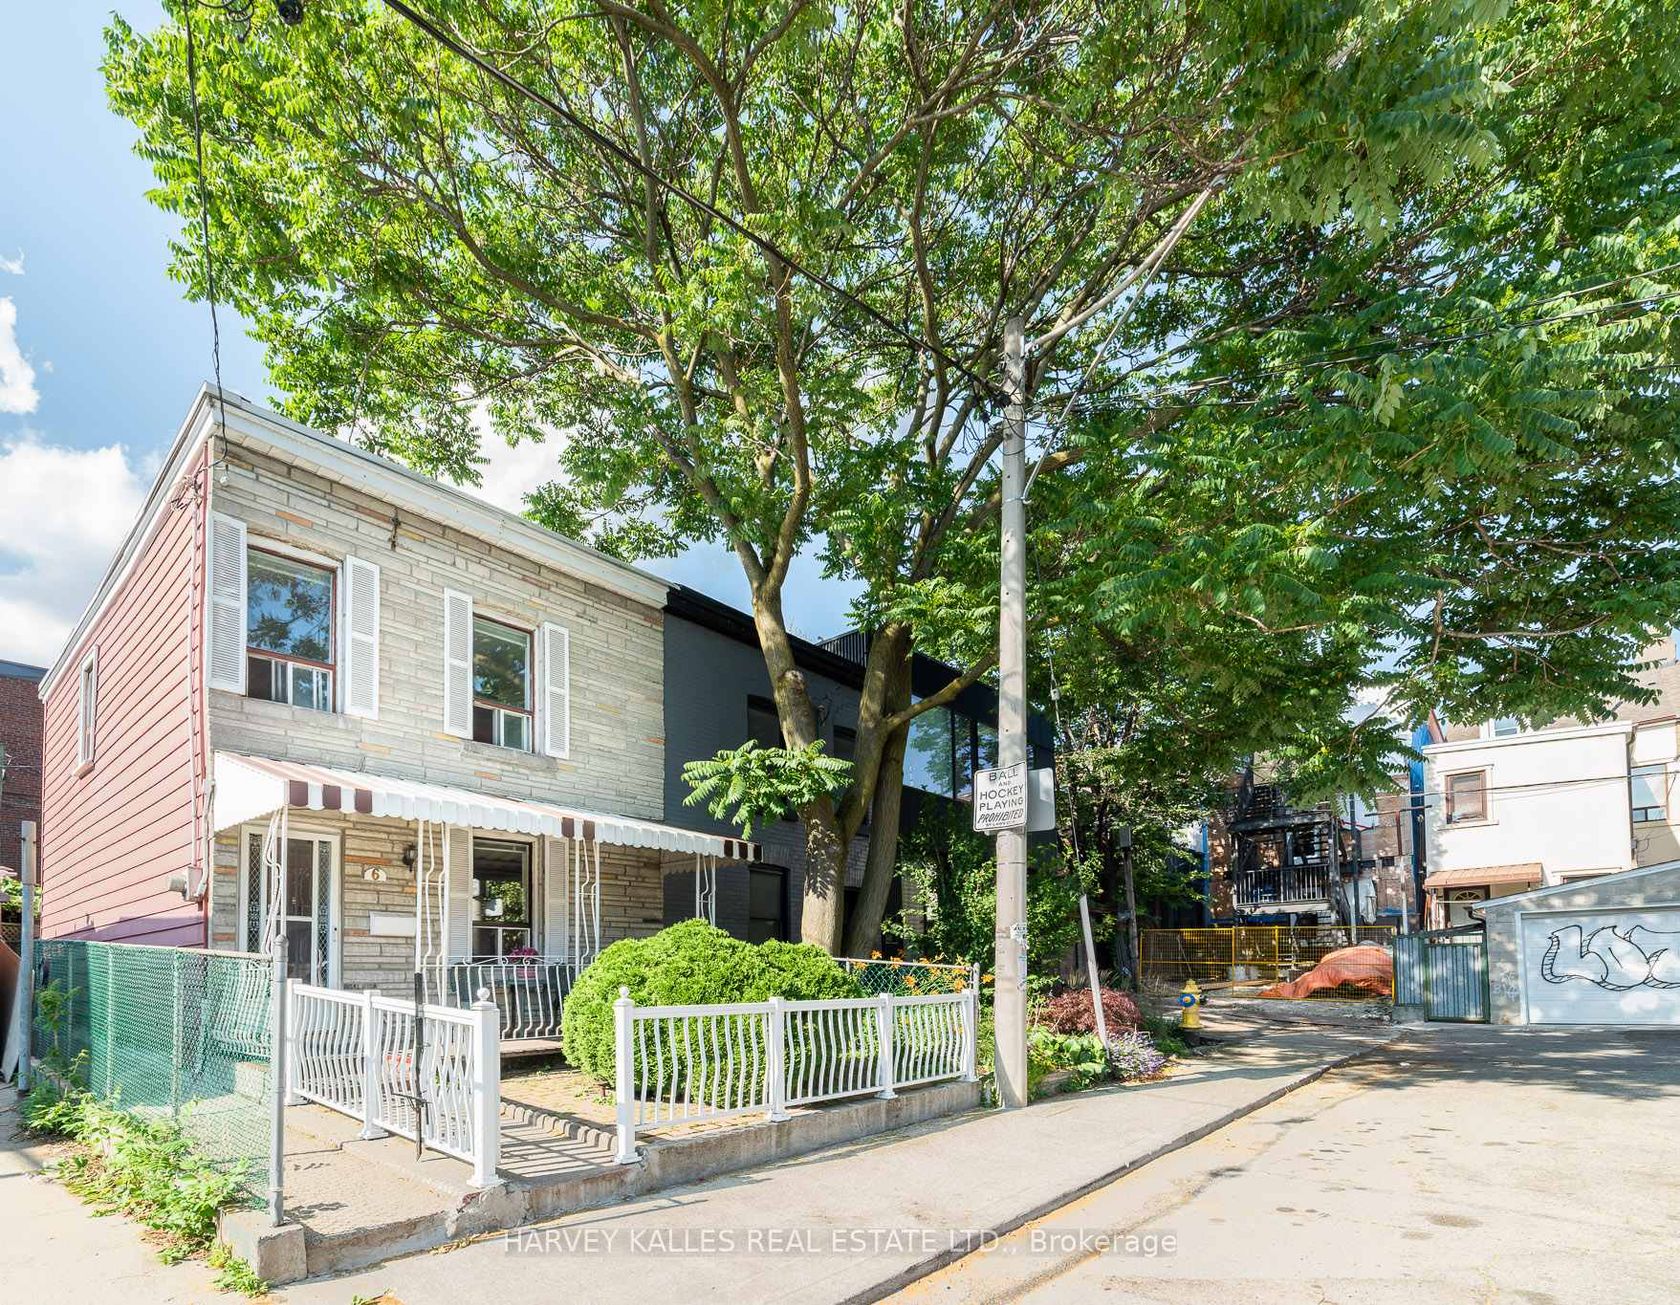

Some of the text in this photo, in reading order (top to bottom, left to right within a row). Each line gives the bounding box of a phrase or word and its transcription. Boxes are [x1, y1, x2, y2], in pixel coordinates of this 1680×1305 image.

[989, 768, 1018, 781] BALL
[980, 784, 1024, 800] HOCKEY
[979, 797, 1024, 811] PLAYING
[977, 808, 1024, 823] PROHIBITED
[371, 868, 379, 880] 6
